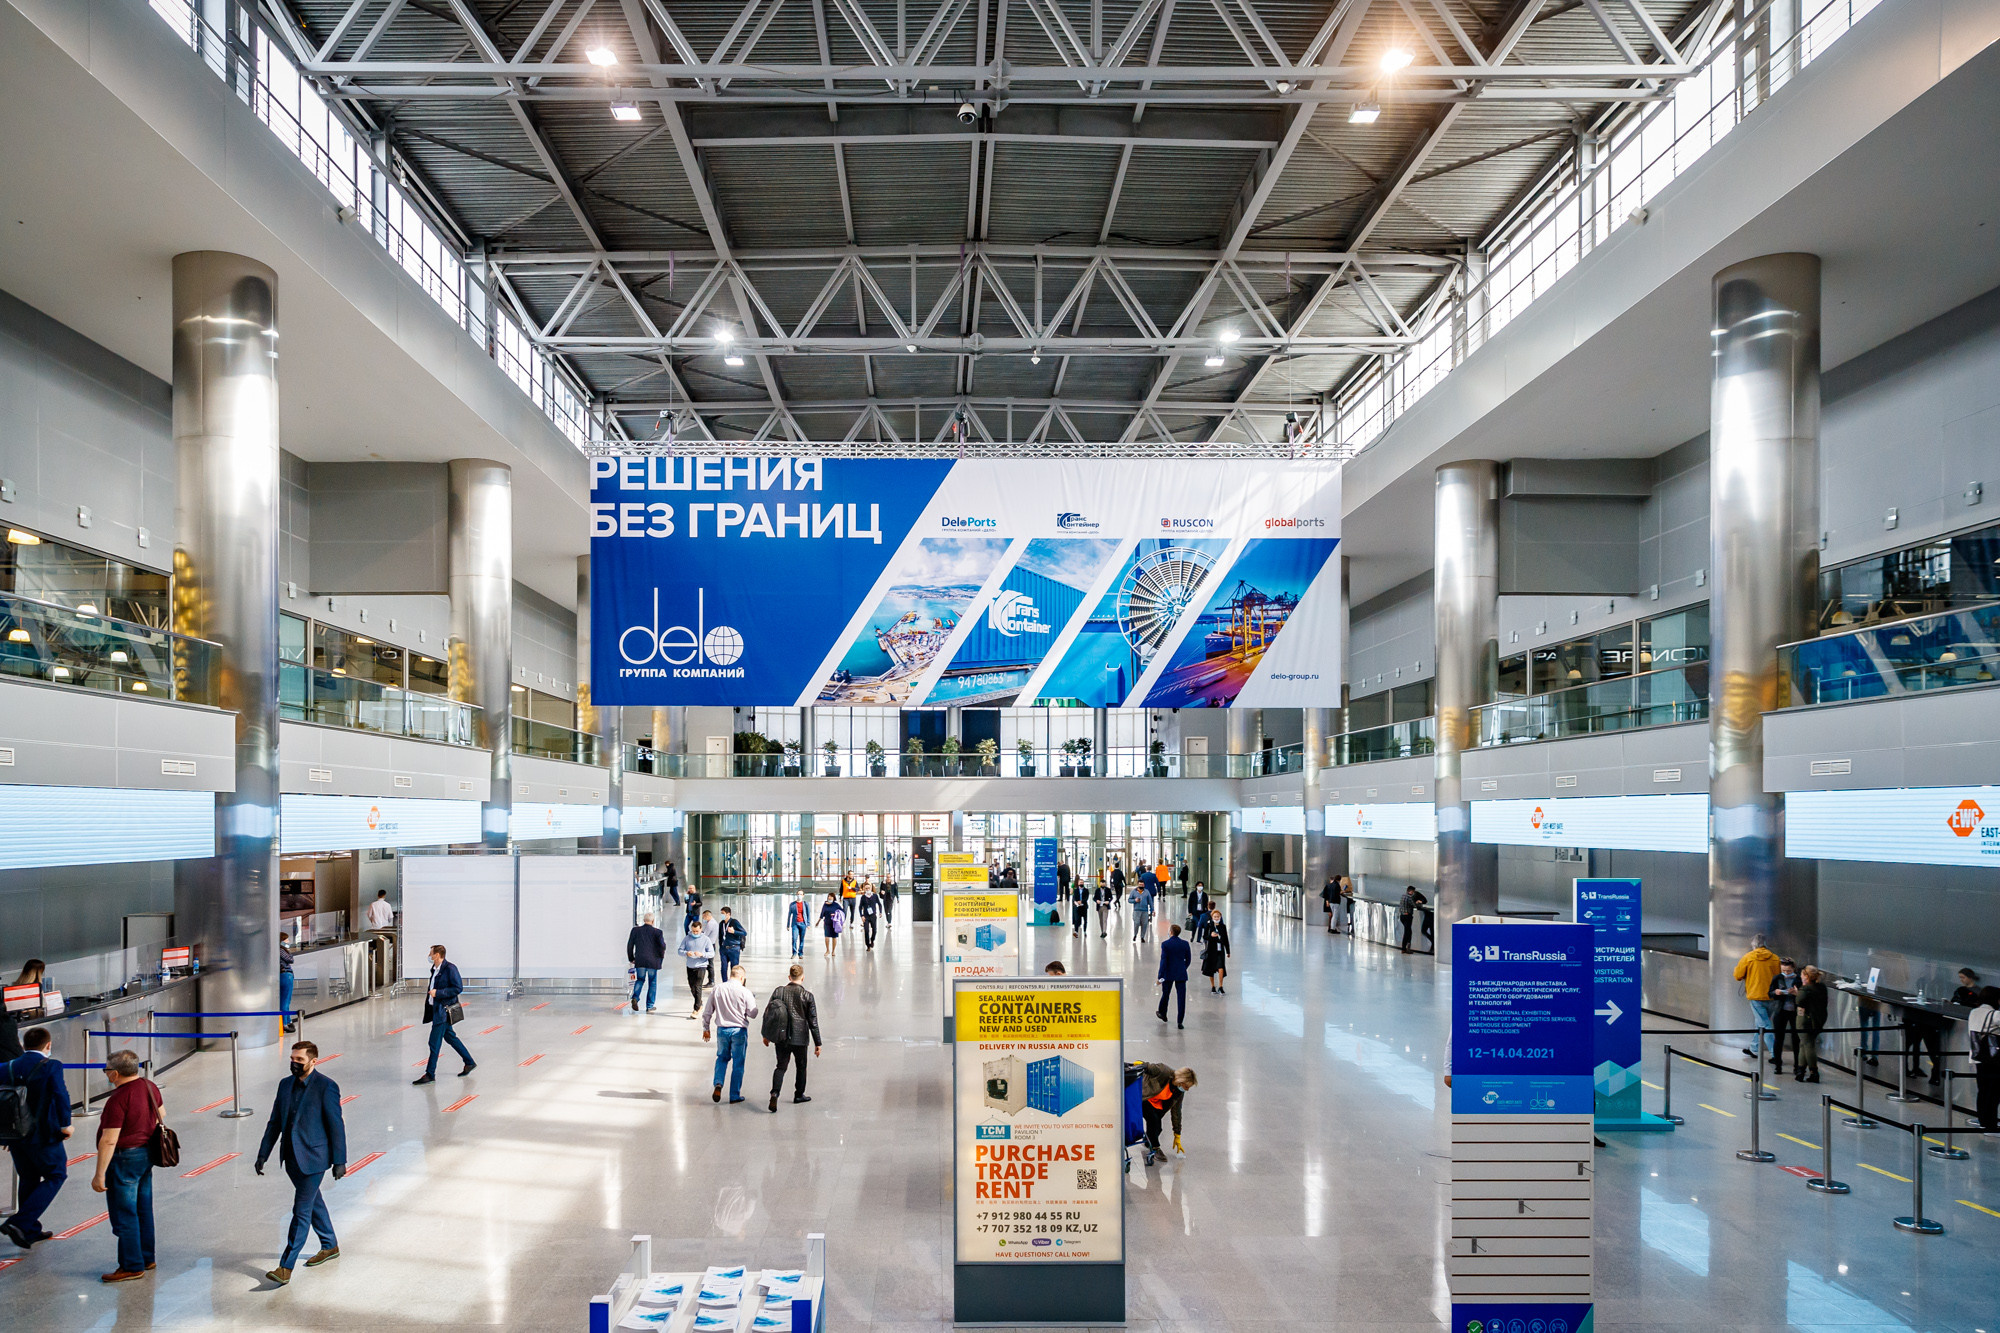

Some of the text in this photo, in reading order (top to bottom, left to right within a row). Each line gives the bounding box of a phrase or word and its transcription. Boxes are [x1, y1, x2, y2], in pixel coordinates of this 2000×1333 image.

[590, 457, 823, 491] РЕШЕНИЯ
[590, 503, 882, 544] БЕЗ ГРАНИЦ
[942, 516, 996, 527] DeloPorts
[1172, 518, 1214, 528] RUSCON
[1264, 517, 1325, 529] globalports
[618, 587, 744, 666] delo
[620, 666, 745, 678] ГРУППА КОМПАНИЙ
[1270, 673, 1319, 682] delo-group.ru
[1952, 808, 1980, 828] EWG
[1503, 951, 1567, 961] TransRussia
[979, 1002, 1082, 1014] CONTAINERS
[979, 1015, 1097, 1024] REEFERS CONTAINERS
[1530, 1091, 1555, 1107] delo
[976, 1145, 1095, 1161] PURCHASE
[975, 1163, 1048, 1179] TRADE
[976, 1181, 1034, 1198] RENT
[976, 1212, 988, 1220] +7
[992, 1212, 1010, 1220] 912
[1013, 1212, 1032, 1220] 980
[1034, 1212, 1047, 1220] 44
[1050, 1212, 1062, 1220] 55
[992, 1224, 1010, 1232] 707
[1013, 1224, 1032, 1232] 352
